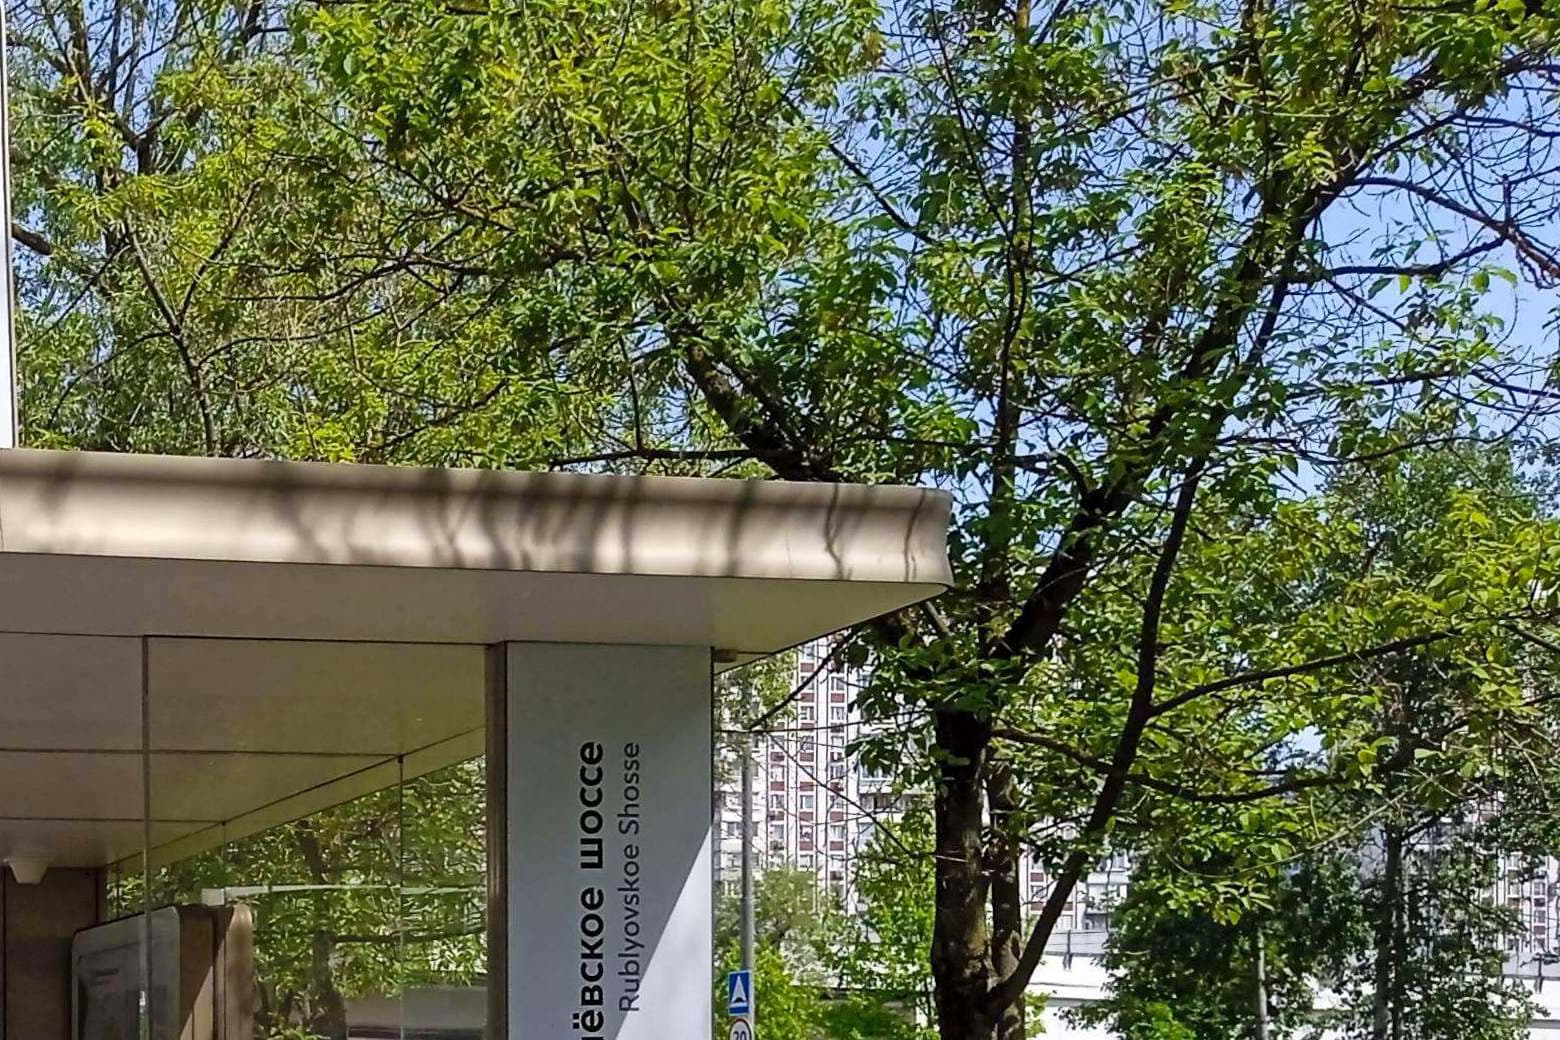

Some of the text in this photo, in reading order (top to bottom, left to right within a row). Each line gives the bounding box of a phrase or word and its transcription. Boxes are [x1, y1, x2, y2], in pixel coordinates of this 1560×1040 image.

[579, 740, 604, 869] шоссе
[618, 742, 645, 1012] Rublyovskoe Shosse
